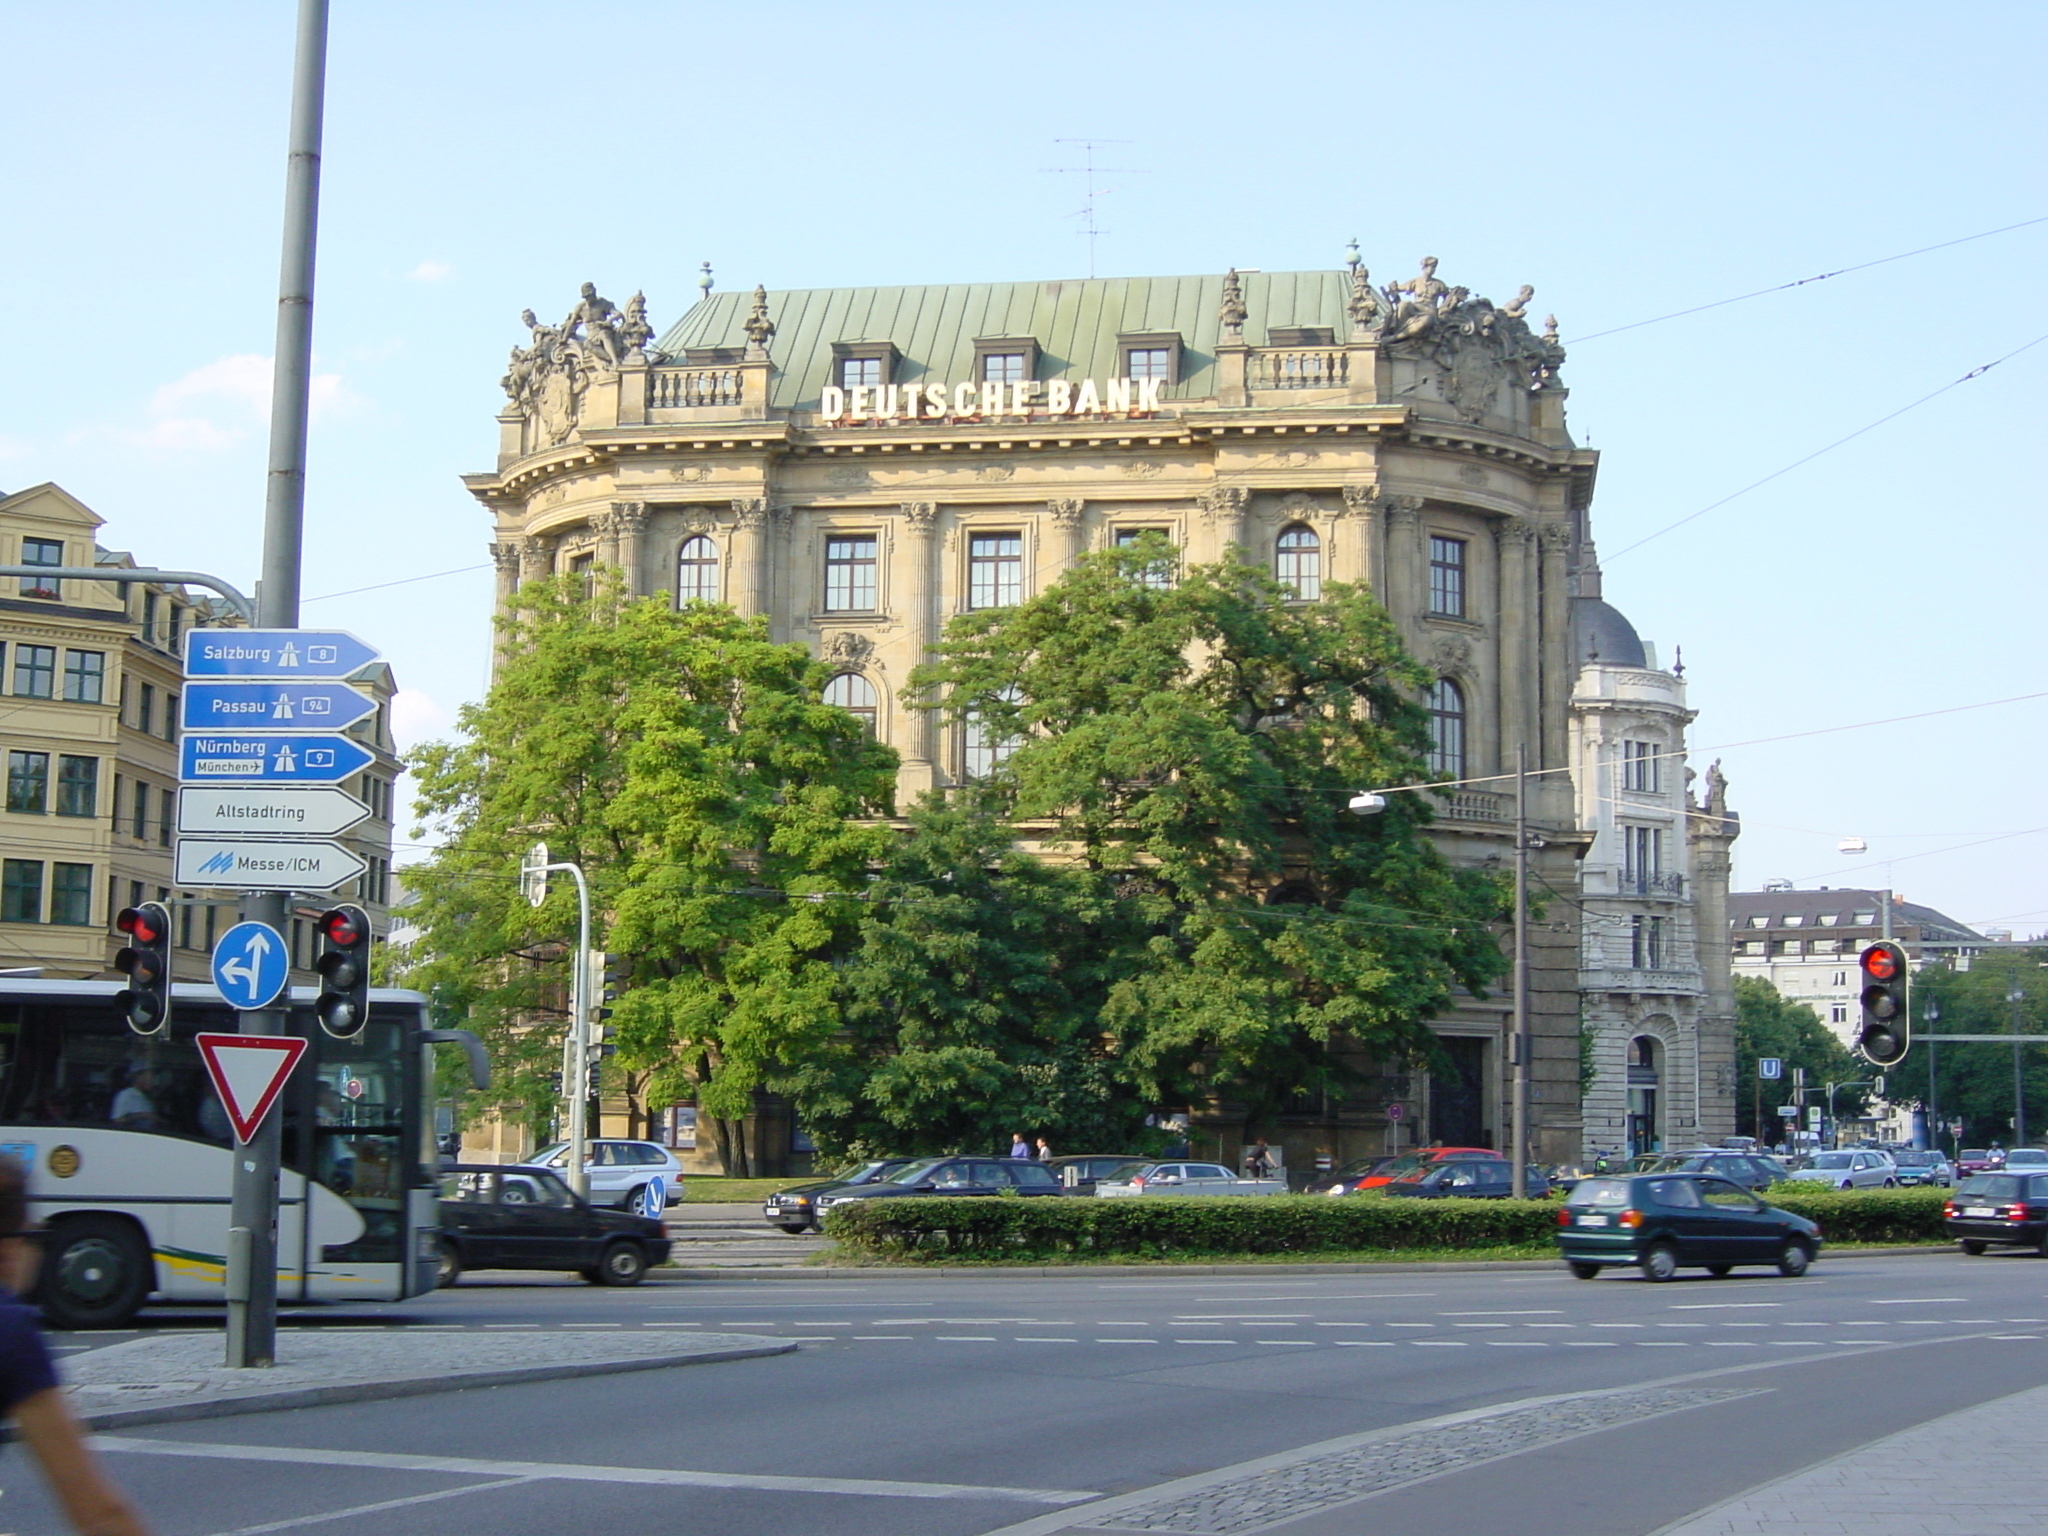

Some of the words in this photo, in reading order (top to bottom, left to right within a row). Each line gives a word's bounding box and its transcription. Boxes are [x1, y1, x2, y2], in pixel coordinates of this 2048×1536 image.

[821, 380, 1030, 421] DEUTSCHE
[1048, 376, 1161, 415] BANK
[203, 645, 271, 662] Salzburg
[319, 649, 327, 660] 8
[212, 699, 266, 713] Passau
[309, 700, 323, 711] 94
[195, 739, 266, 756] Nürnberg
[316, 753, 324, 764] 9
[197, 761, 249, 773] München
[215, 805, 305, 822] Altstadtring
[237, 857, 320, 872] Messe/ICM
[1763, 1061, 1776, 1076] U
